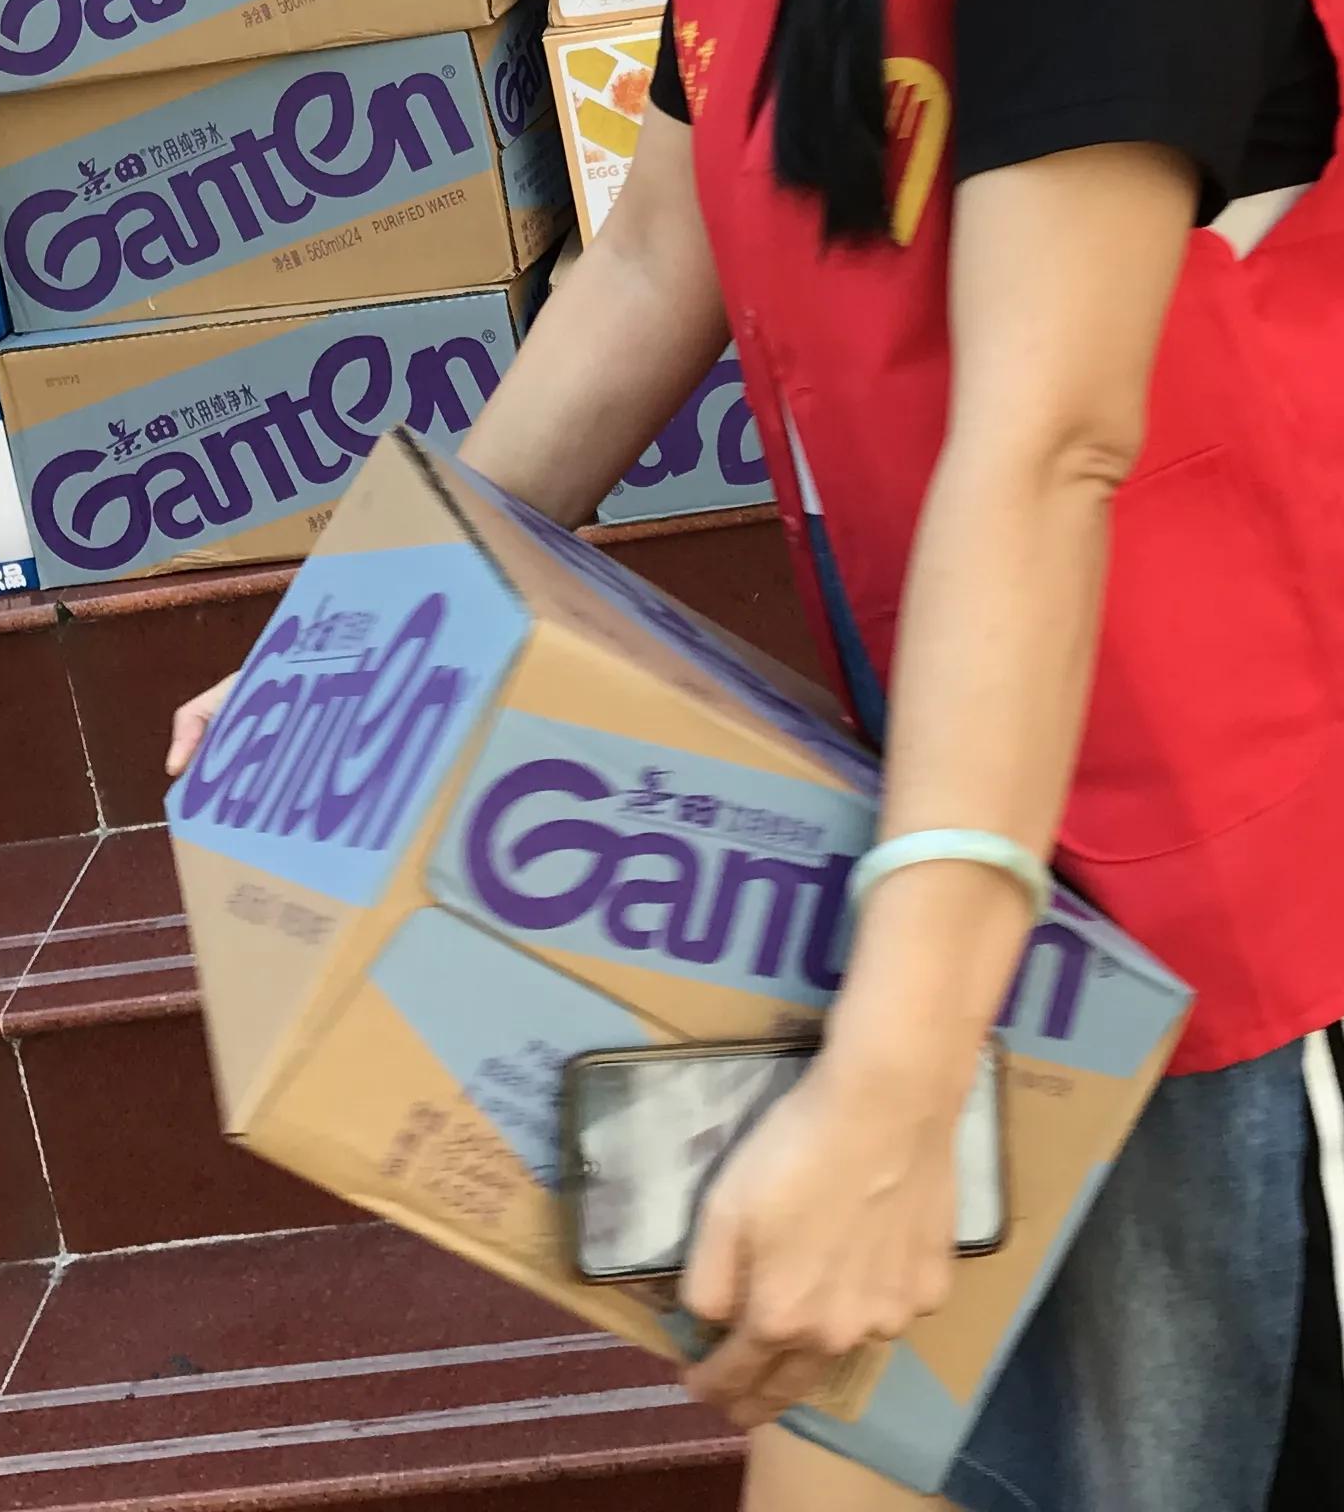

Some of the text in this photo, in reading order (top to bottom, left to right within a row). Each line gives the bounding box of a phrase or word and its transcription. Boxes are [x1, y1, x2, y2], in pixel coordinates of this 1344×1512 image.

[148, 121, 224, 169] 饮用纯净水
[3, 71, 474, 312] Ganten
[587, 165, 619, 180] EGG
[371, 204, 426, 234] PURIFIED
[427, 188, 467, 214] WATER
[180, 383, 258, 432] 饮用纯净水
[31, 334, 502, 571] Ganten
[180, 592, 468, 851] Ganten
